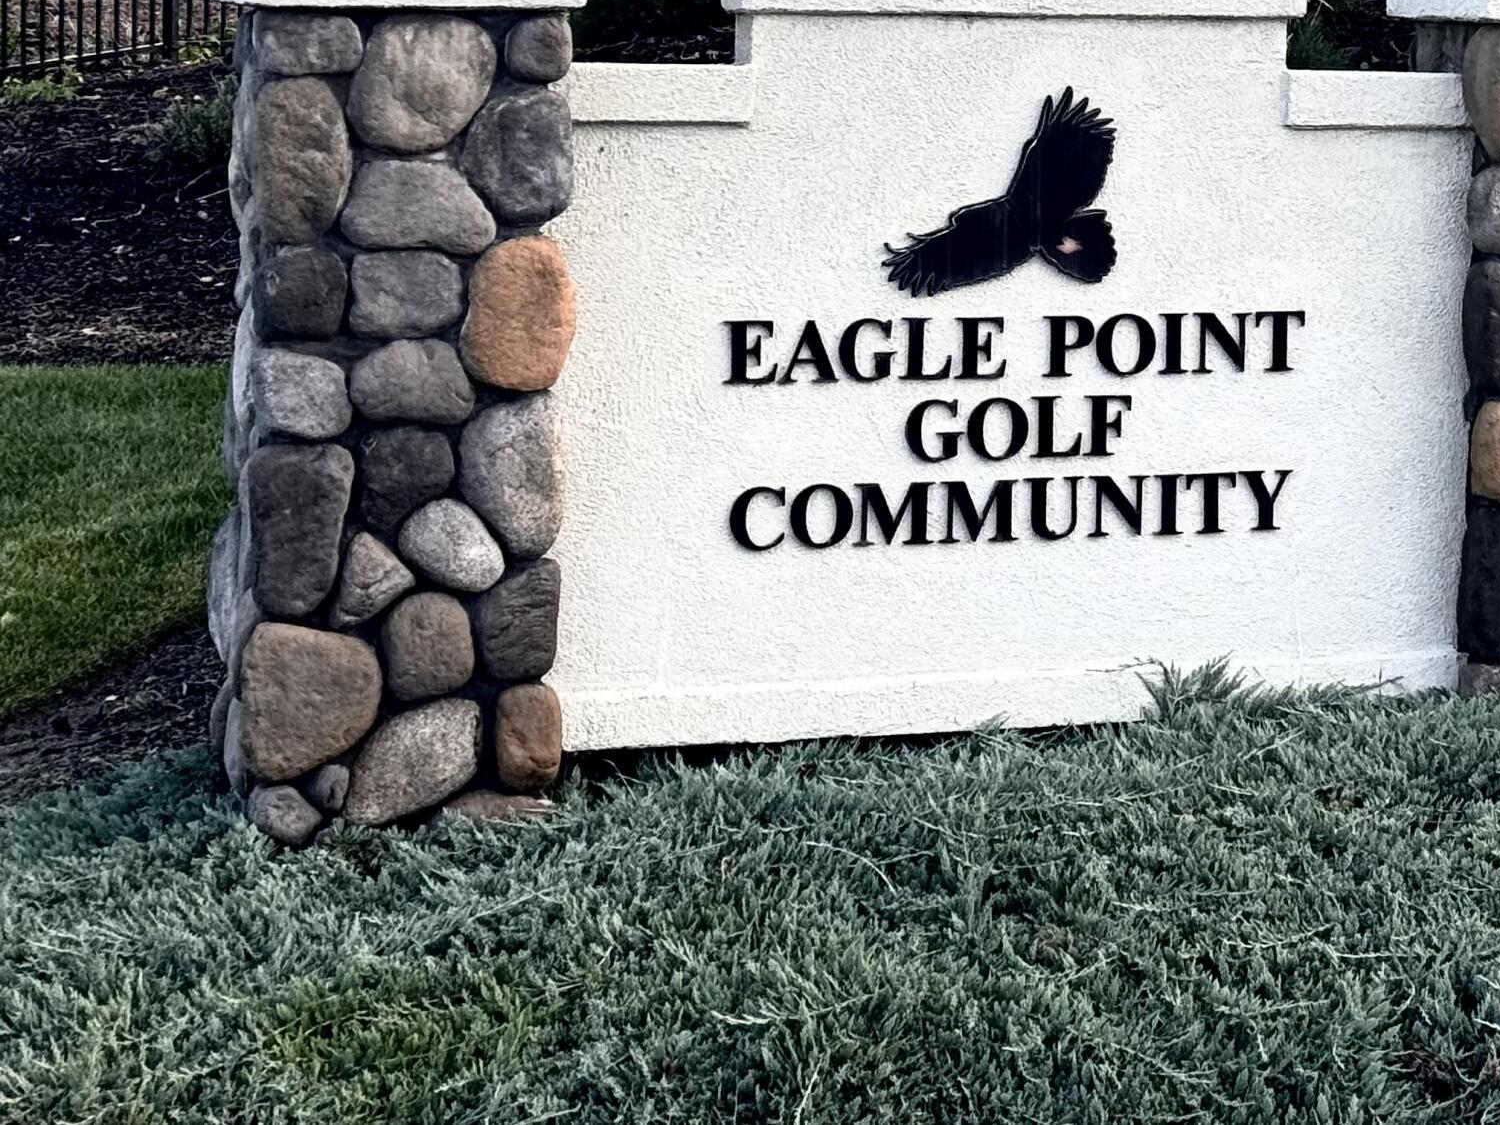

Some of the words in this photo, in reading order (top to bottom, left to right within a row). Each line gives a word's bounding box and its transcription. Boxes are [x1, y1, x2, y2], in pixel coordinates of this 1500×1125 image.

[722, 316, 1007, 387] EAGLE
[1042, 310, 1306, 378] POINT
[904, 394, 1132, 463] GOLF
[728, 469, 1294, 553] COMMUNITY
